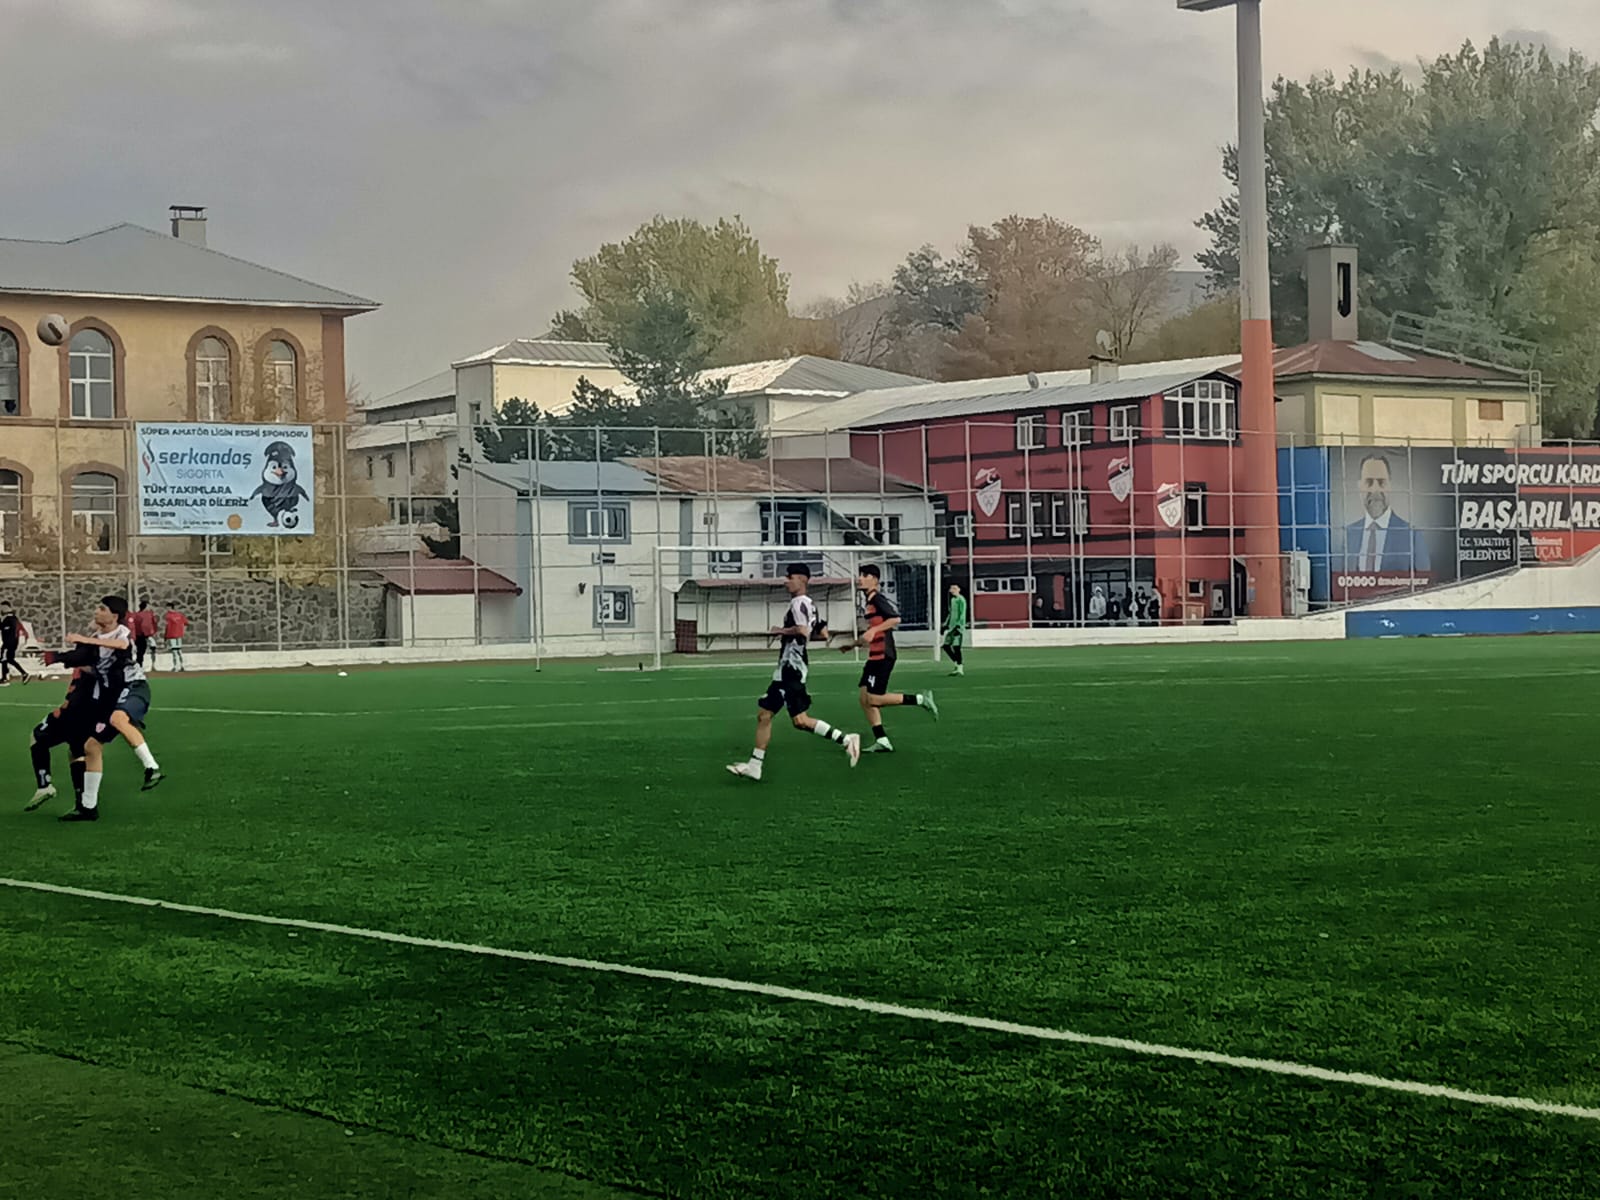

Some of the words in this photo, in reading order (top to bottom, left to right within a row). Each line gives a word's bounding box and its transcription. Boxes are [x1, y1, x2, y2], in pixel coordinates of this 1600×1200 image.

[141, 427, 170, 435] SÜPER
[172, 427, 209, 436] AMATÖR
[262, 429, 309, 438] SPONSORU
[159, 447, 252, 469] serkandaş
[1440, 459, 1480, 484] TÜM
[1481, 463, 1554, 485] SPORCU
[1555, 463, 1600, 484] KARD
[143, 483, 168, 494] TÜM
[171, 485, 233, 495] TAKIMLARA
[143, 497, 207, 508] BAŞARILAR
[209, 496, 249, 507] DİLERİZ
[1459, 500, 1600, 535] BAŞARILAR
[1534, 546, 1563, 561] UÇAR
